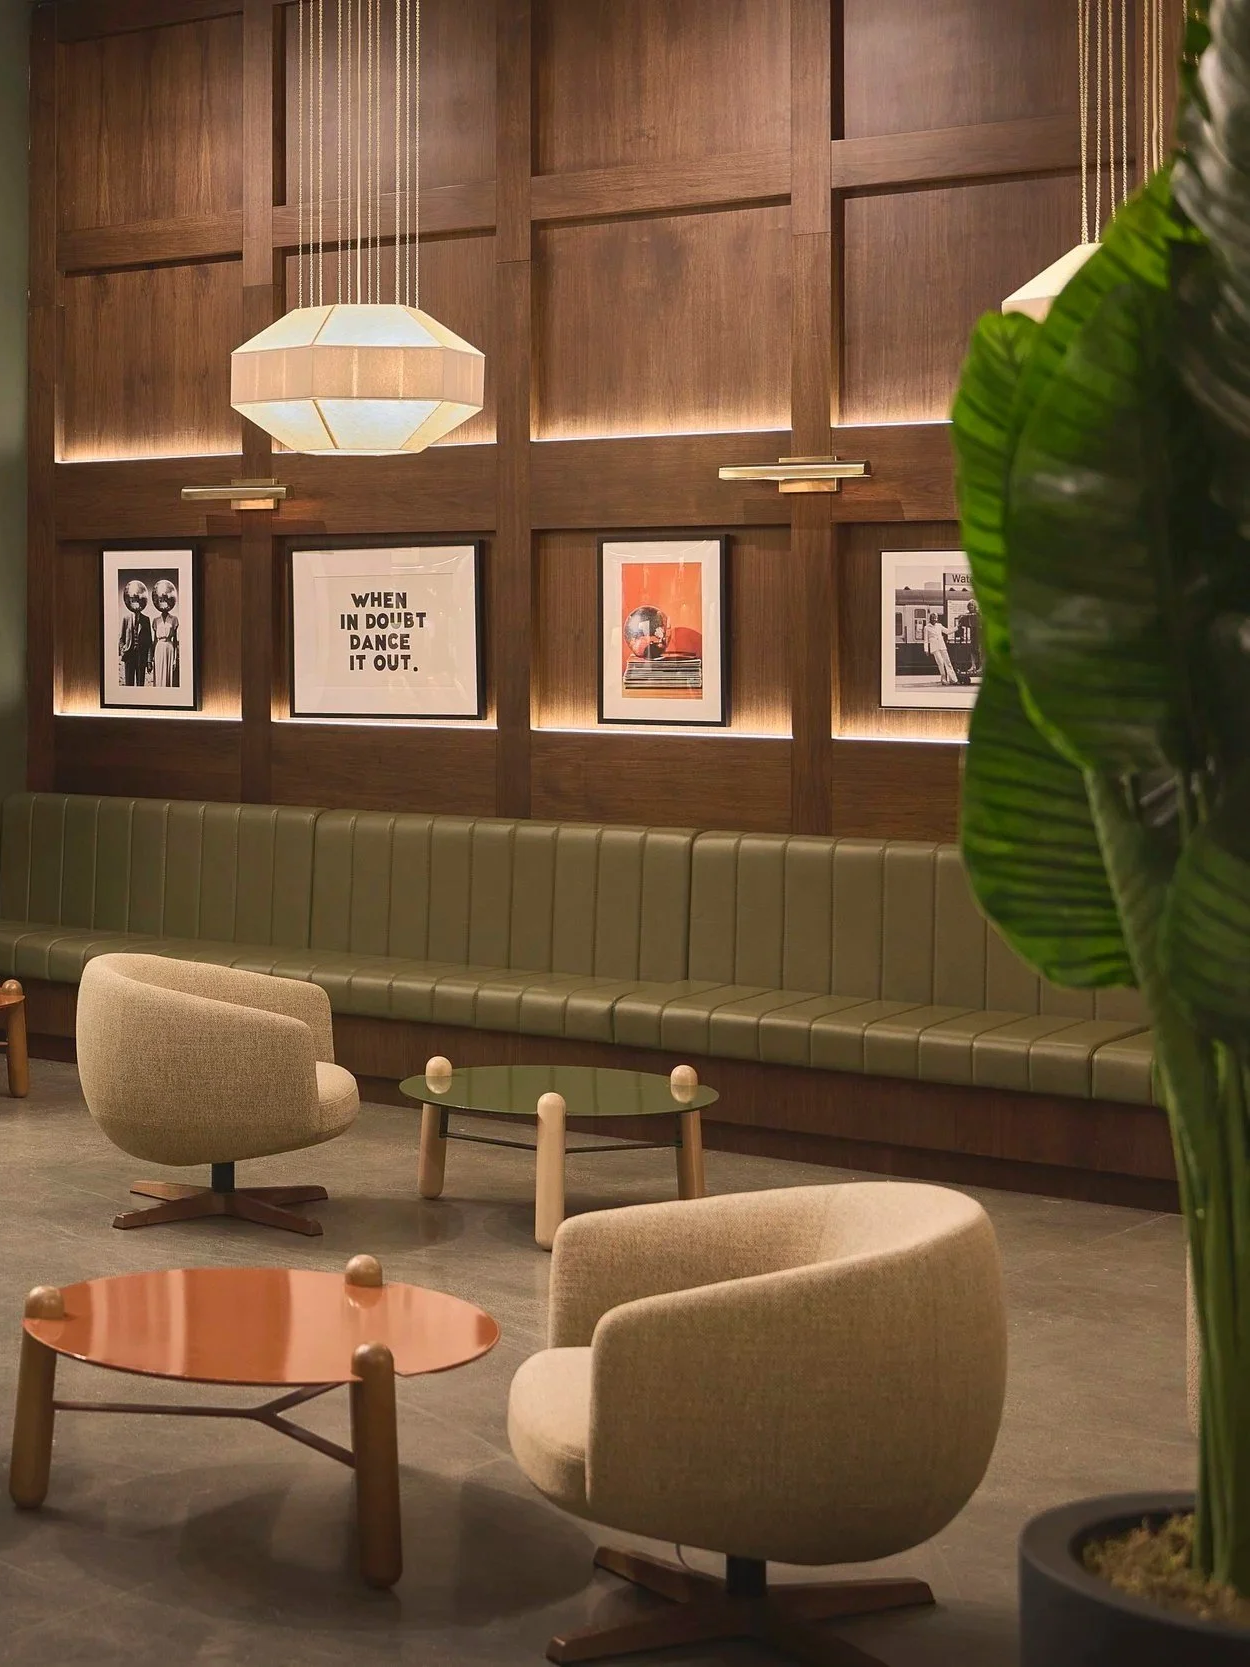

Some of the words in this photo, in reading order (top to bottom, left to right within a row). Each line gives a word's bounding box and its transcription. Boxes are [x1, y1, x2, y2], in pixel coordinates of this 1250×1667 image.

[351, 591, 407, 609] WHEN
[340, 613, 359, 631] IN
[365, 611, 427, 630] DOUBT
[349, 632, 411, 651] DANCE
[349, 654, 366, 671] IT
[373, 654, 419, 672] OUT.
